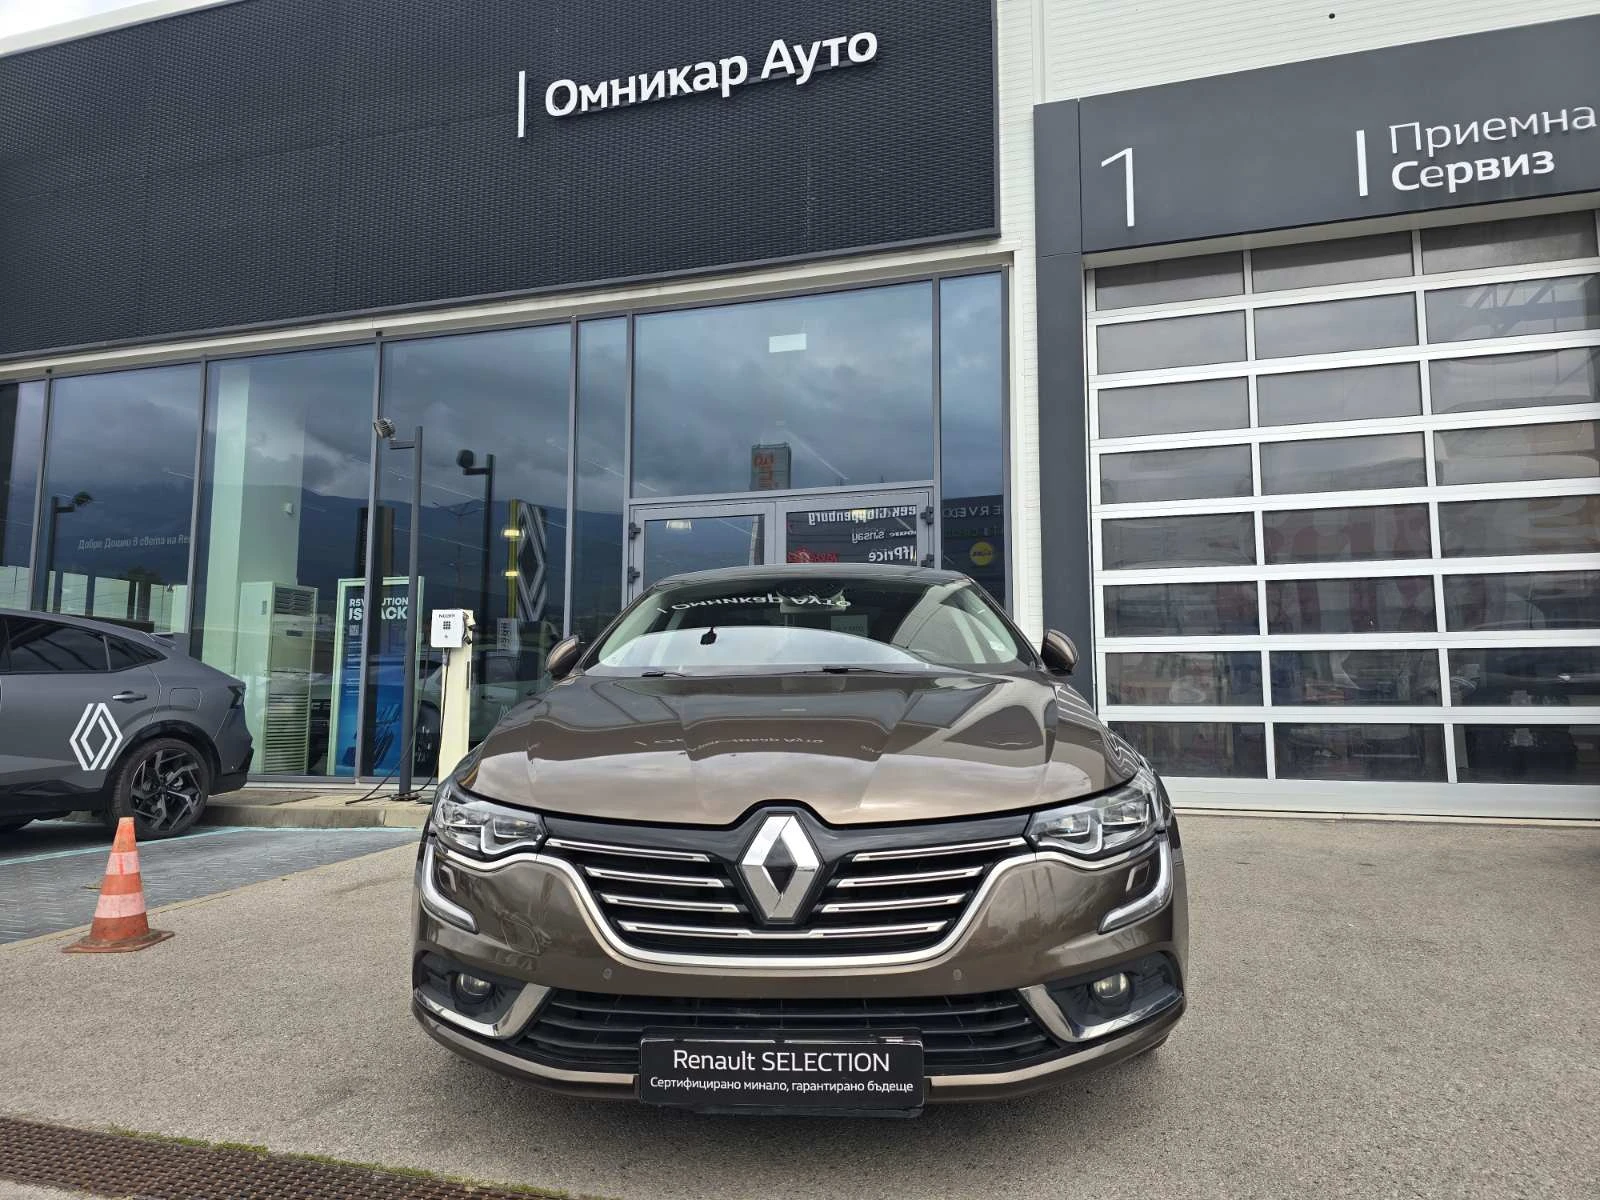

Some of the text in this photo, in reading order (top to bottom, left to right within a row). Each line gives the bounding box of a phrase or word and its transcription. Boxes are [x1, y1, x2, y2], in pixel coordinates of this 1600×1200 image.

[545, 32, 878, 117] Омникар Ауто
[1389, 106, 1597, 157] Приемна
[1101, 147, 1135, 227] 1
[1391, 149, 1555, 193] Сервиз
[673, 1050, 890, 1072] Renault SELECTION
[650, 1077, 914, 1093] Сертифицирано минало, гарантирано бъдеще
